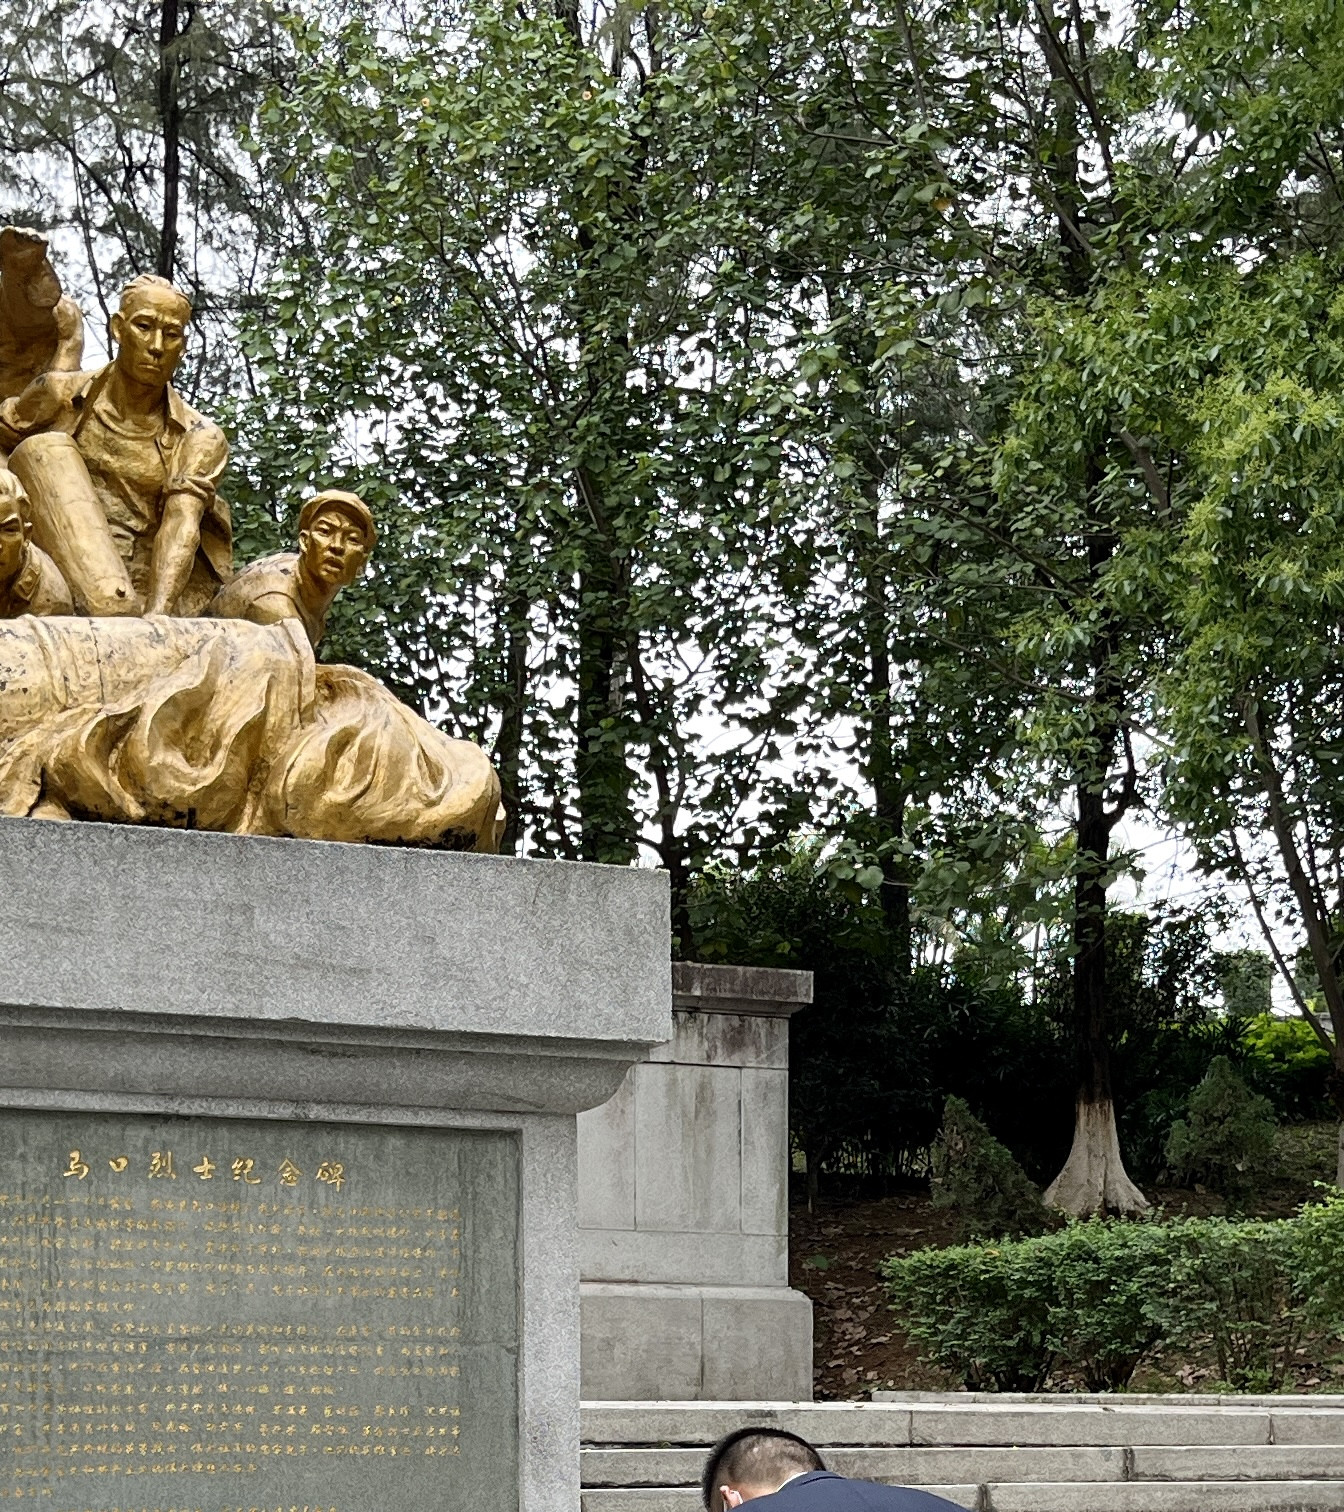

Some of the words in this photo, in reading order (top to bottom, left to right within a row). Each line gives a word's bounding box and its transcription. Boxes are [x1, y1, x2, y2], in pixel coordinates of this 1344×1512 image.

[63, 1149, 346, 1192] 马口烈士纪念碑
